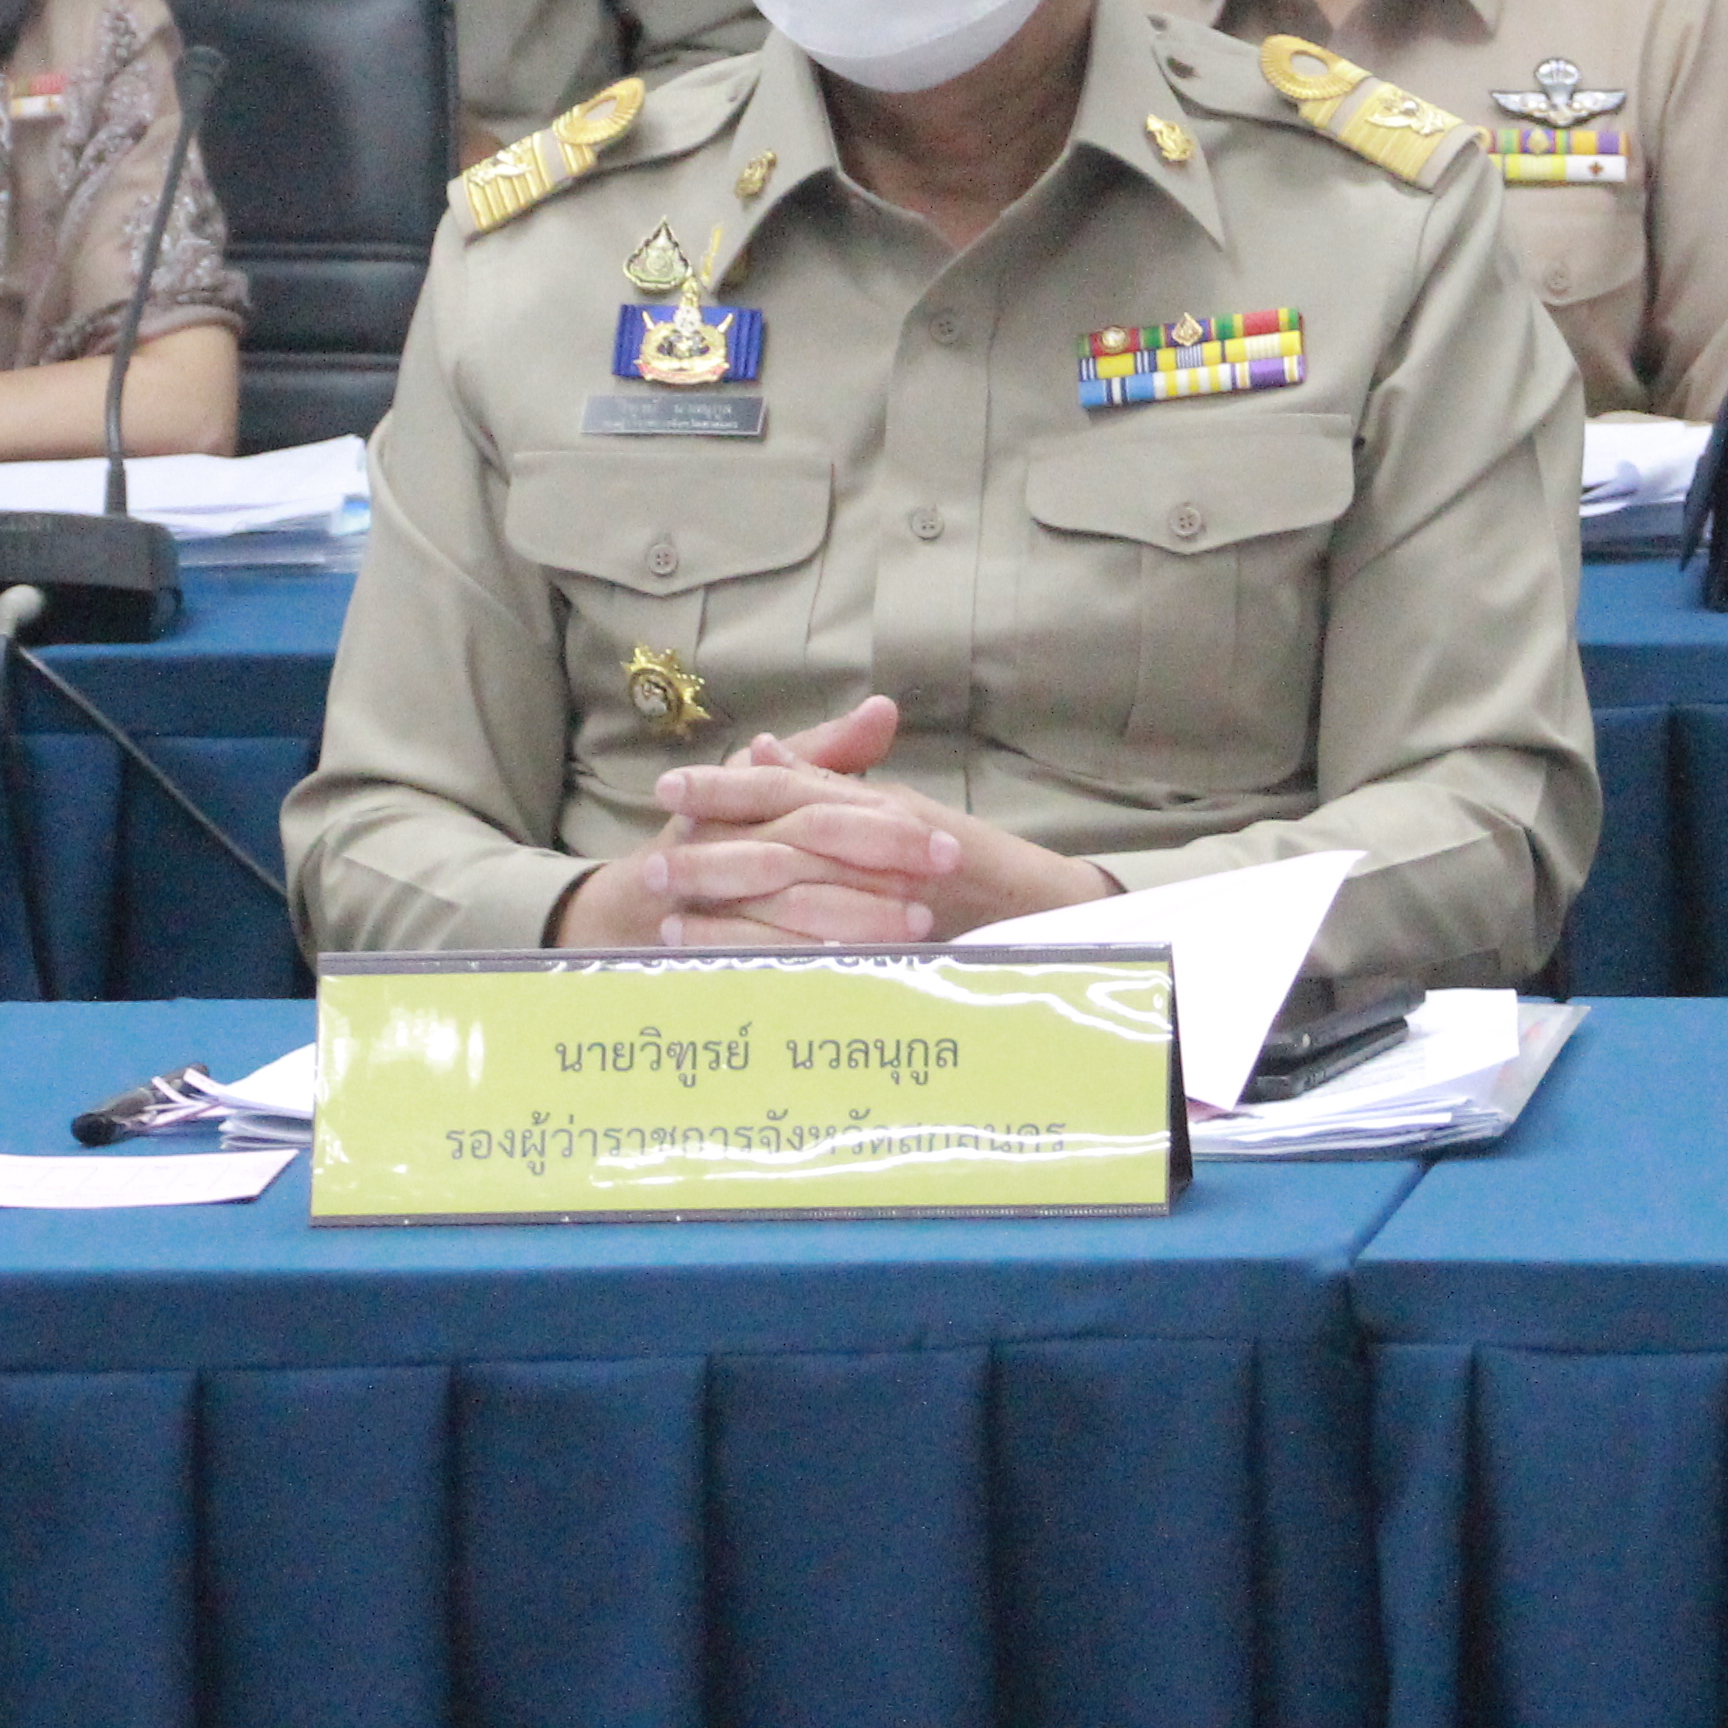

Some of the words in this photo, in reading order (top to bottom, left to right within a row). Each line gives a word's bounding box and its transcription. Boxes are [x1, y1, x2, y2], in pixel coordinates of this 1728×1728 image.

[554, 1021, 753, 1088] นายวิฑูรย์
[785, 1037, 960, 1086] นวลนุกูล
